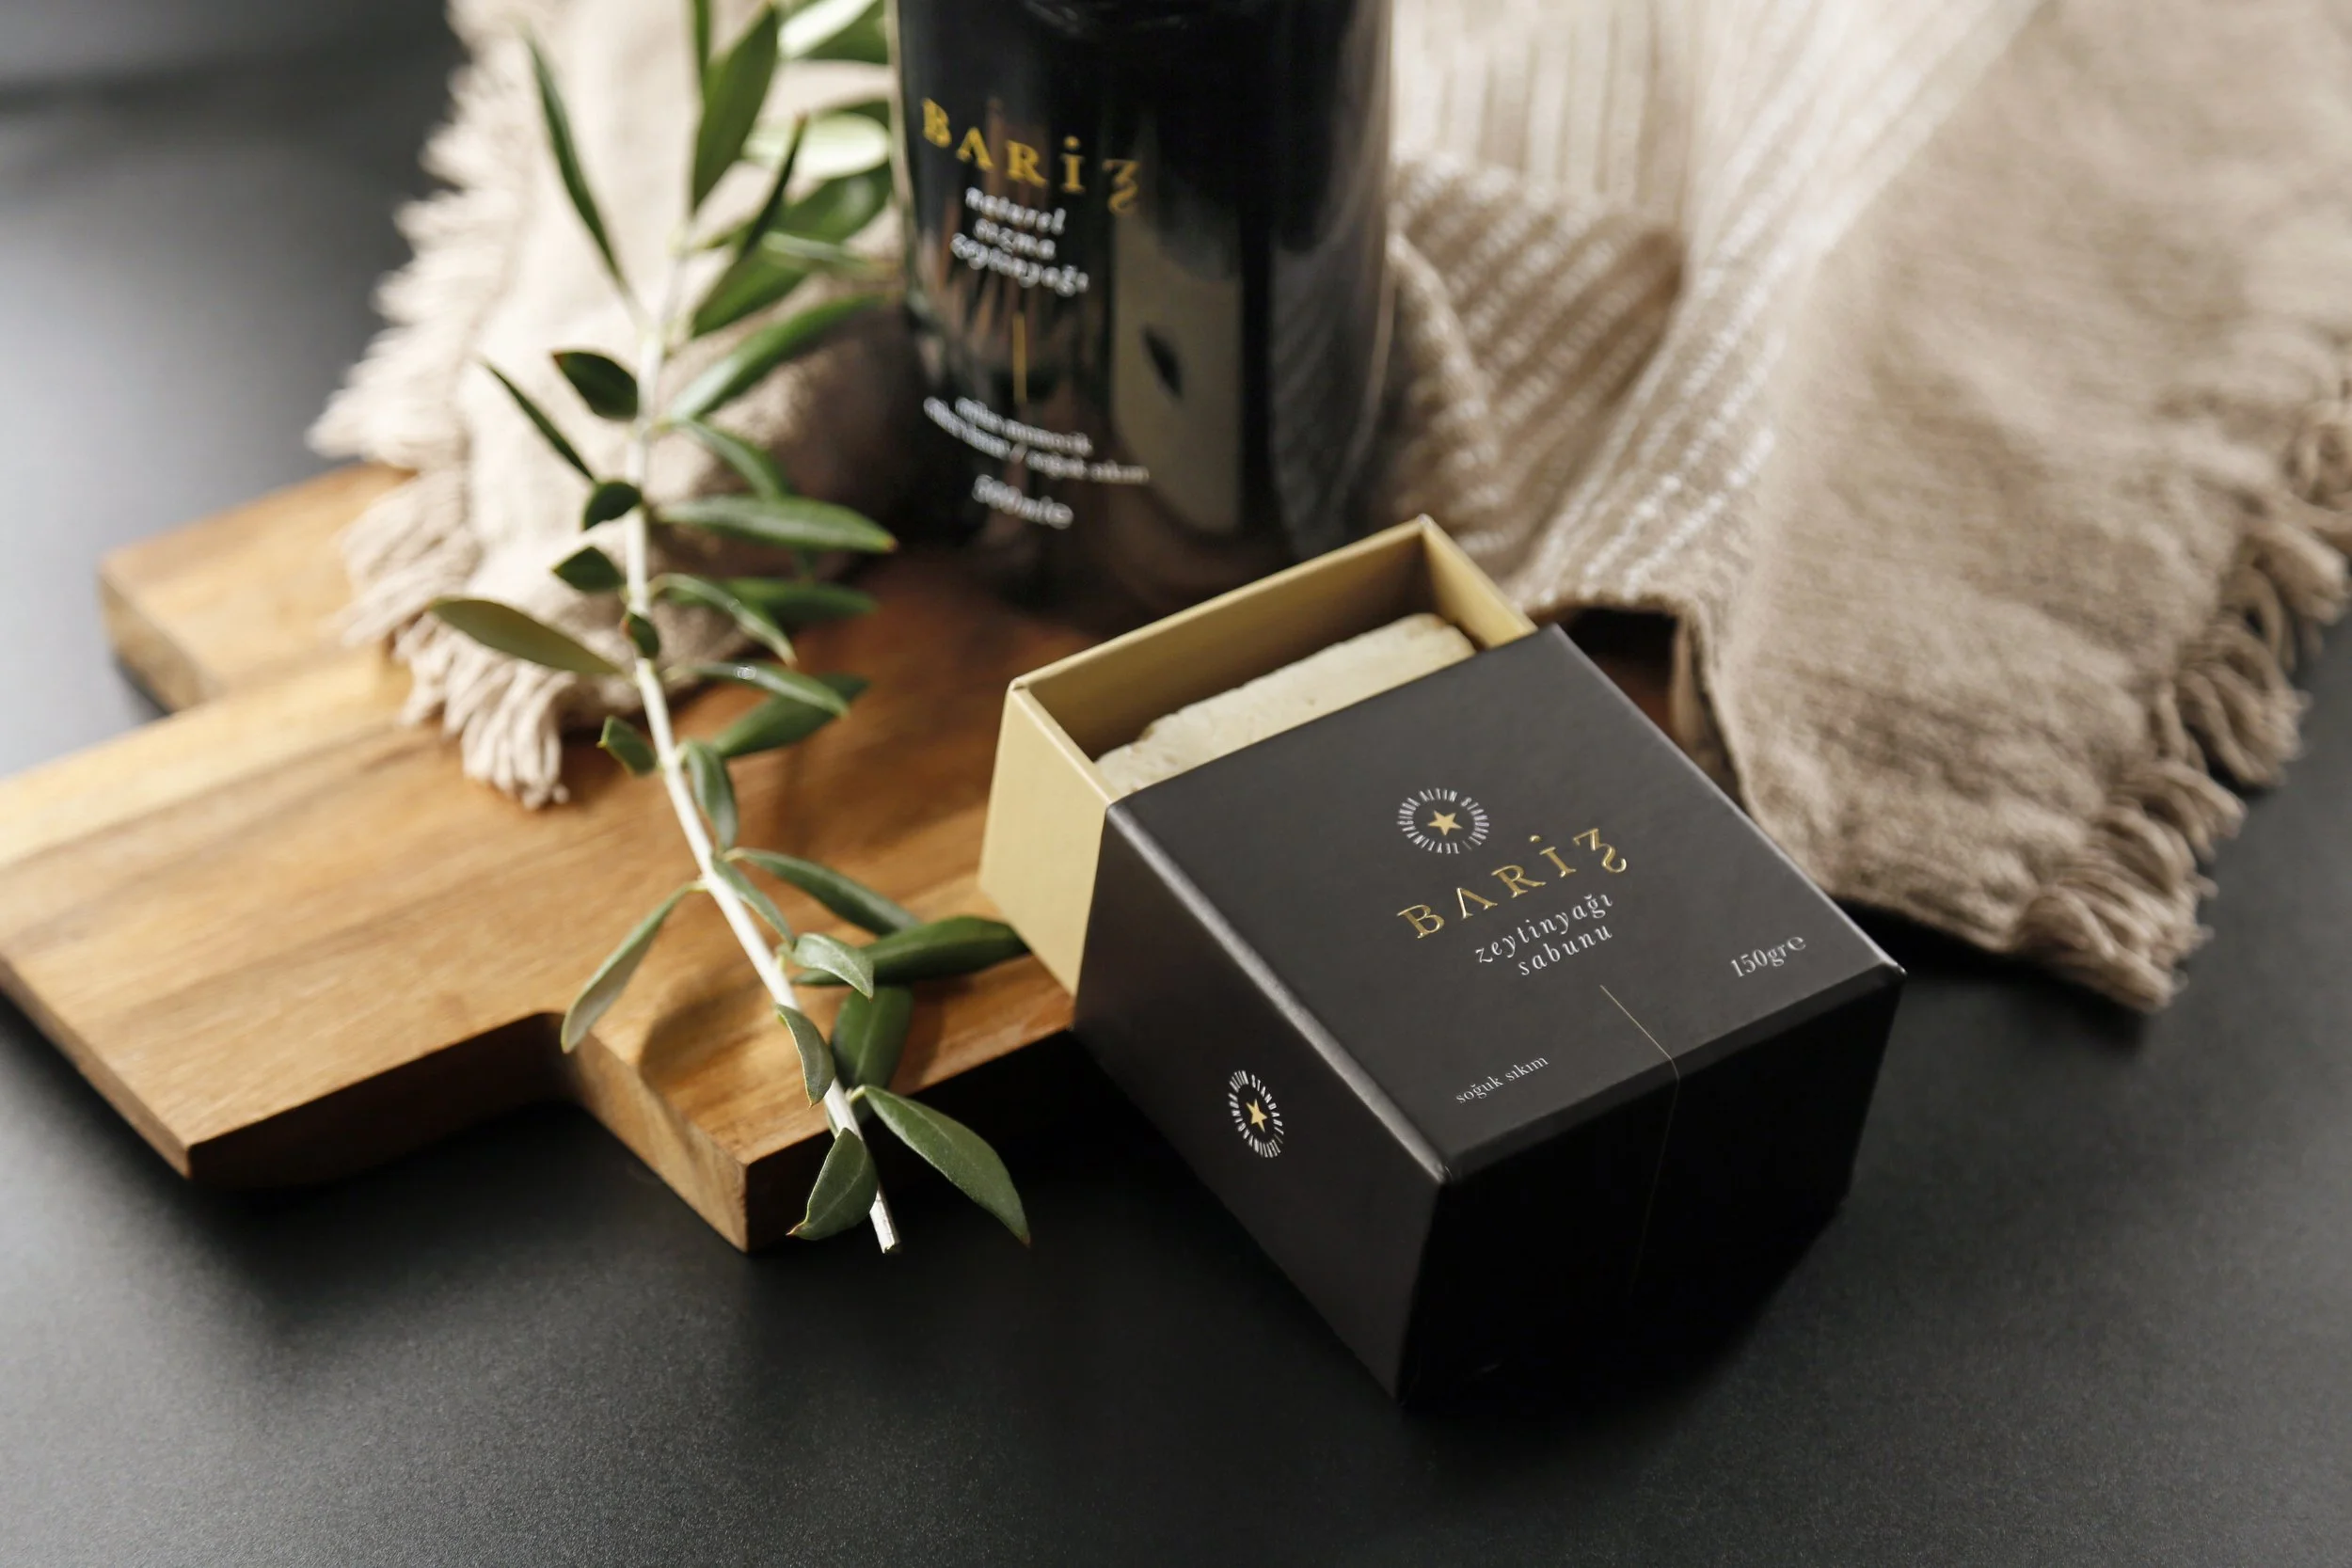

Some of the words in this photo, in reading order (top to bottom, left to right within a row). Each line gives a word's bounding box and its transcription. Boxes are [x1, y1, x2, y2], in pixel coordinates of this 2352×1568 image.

[1475, 893, 1613, 963] zeytinyağı
[1518, 924, 1613, 975] sabunu
[1455, 1076, 1504, 1103] soğuk
[1505, 1057, 1549, 1082] sıkım
